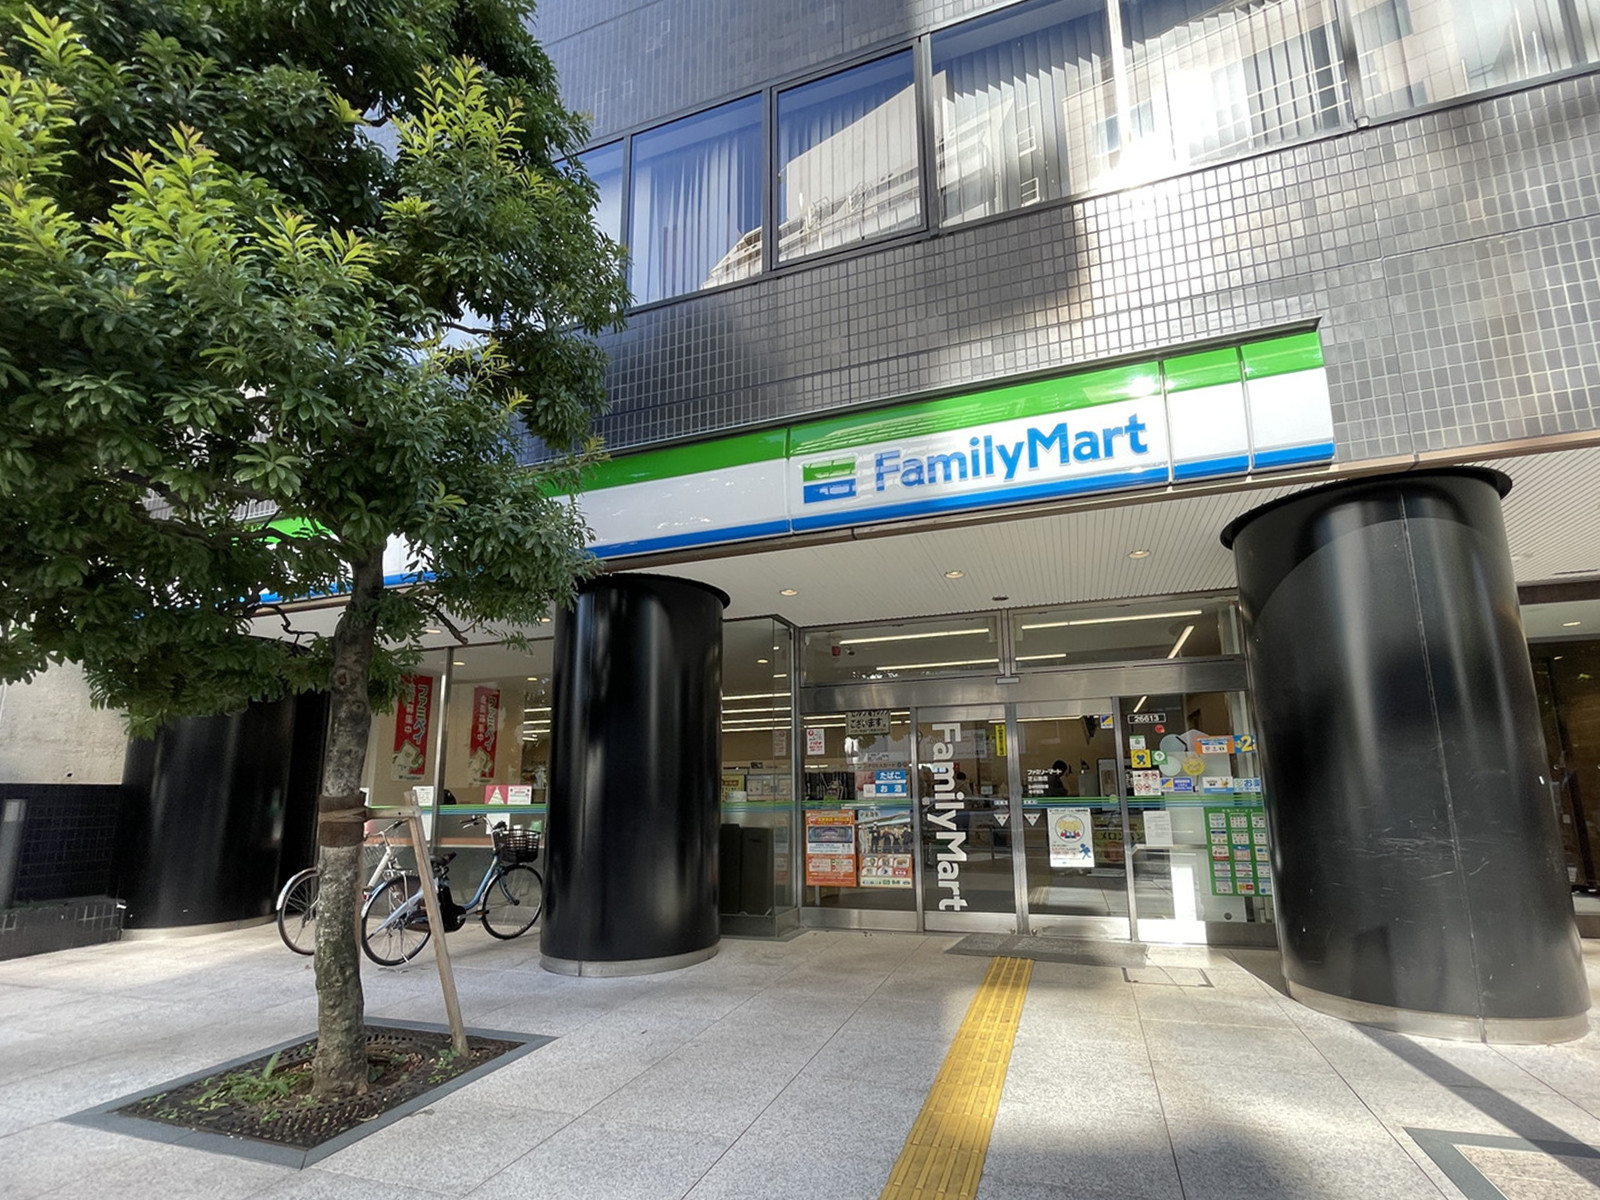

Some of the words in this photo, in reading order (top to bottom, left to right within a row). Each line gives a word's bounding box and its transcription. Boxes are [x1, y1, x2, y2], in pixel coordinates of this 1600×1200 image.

[874, 413, 1149, 491] FamilyMart
[413, 684, 429, 744] ファミペイ
[484, 696, 497, 751] ファミペイ
[880, 771, 902, 779] たばこ
[926, 722, 968, 911] FamilyMart
